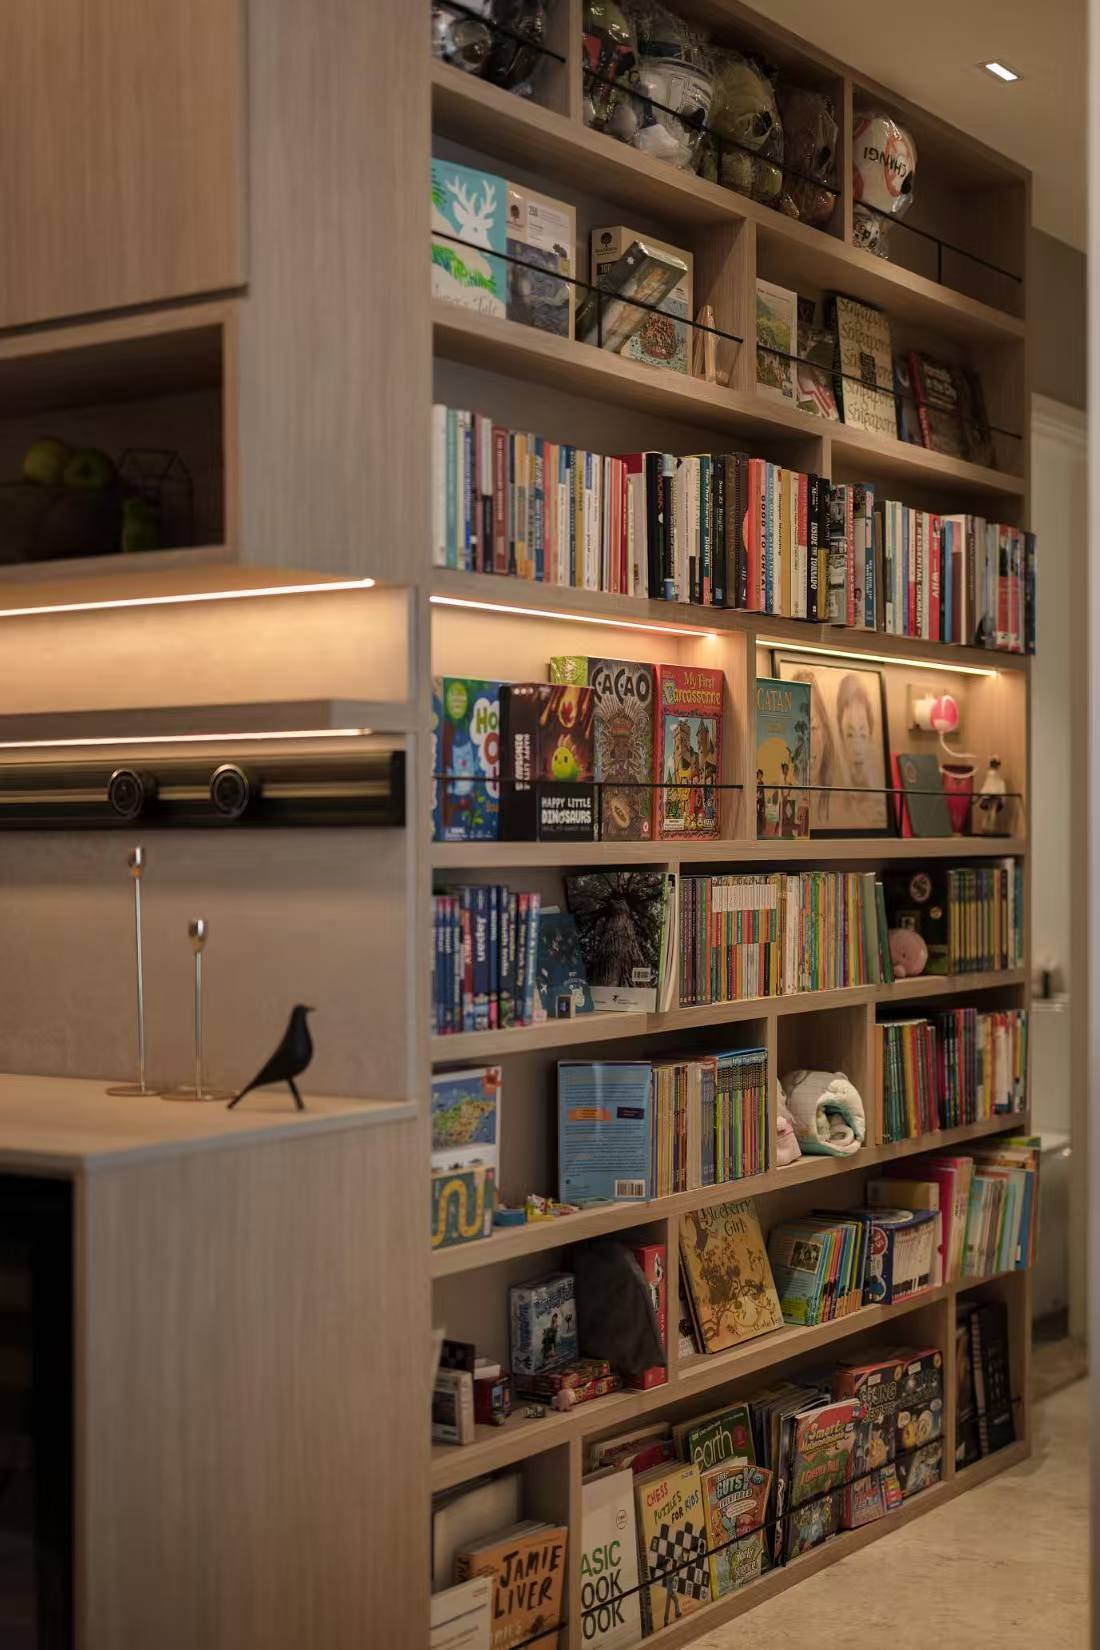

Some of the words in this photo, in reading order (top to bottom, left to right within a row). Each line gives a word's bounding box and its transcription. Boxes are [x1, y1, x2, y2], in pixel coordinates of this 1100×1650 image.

[760, 533, 766, 550] TO
[810, 521, 818, 546] INSIDE
[810, 557, 818, 591] TORNADO
[932, 571, 940, 599] WHY
[591, 665, 650, 704] CACAO
[683, 671, 699, 690] My
[756, 687, 792, 713] CATAN
[541, 796, 564, 809] HAPPY
[567, 797, 592, 808] LITTLE
[541, 810, 592, 824] DINOSAURS
[475, 916, 487, 962] Japan
[723, 1218, 746, 1238] Girl
[694, 1426, 734, 1468] earth
[646, 1481, 669, 1507] CHESS
[653, 1490, 682, 1525] PUZZLES
[671, 1508, 684, 1524] FOR
[684, 1489, 699, 1513] KIDS
[500, 1544, 563, 1589] JAMIE
[580, 1540, 622, 1577] ASIC
[494, 1576, 553, 1620] LIVER
[581, 1569, 624, 1610] OOK
[582, 1599, 625, 1640] OOK
